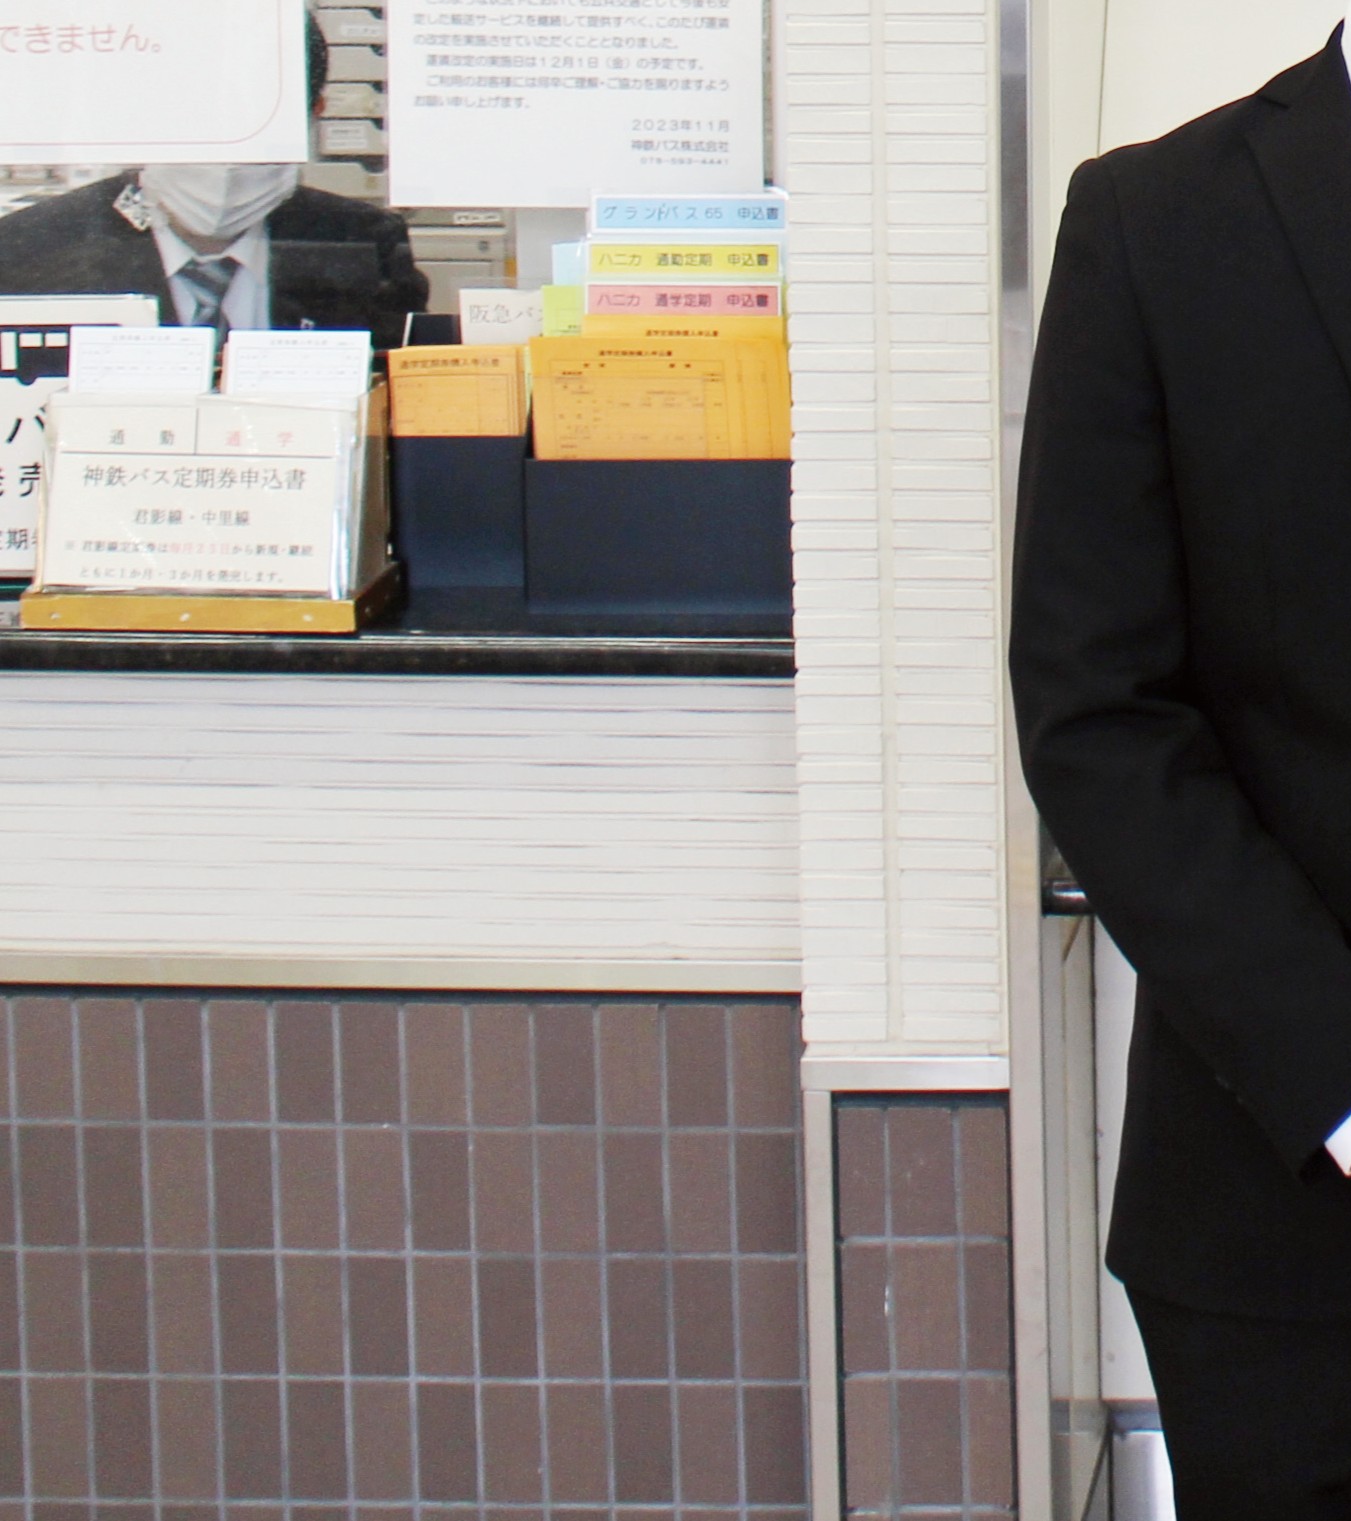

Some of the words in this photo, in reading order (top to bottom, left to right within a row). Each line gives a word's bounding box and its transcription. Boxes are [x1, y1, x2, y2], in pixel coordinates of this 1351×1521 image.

[0, 24, 162, 54] できません。
[705, 207, 723, 219] 65
[738, 207, 779, 220] 申込書
[599, 254, 642, 266] ハニカ
[656, 253, 712, 267] 通勤定期
[727, 253, 769, 266] 申込書
[597, 294, 641, 306] ハニカ
[655, 294, 712, 307] 通学定期
[727, 294, 769, 307] 申込書
[469, 305, 543, 324] 阪急バ
[83, 465, 306, 490] 神鉄バス定期券申込書
